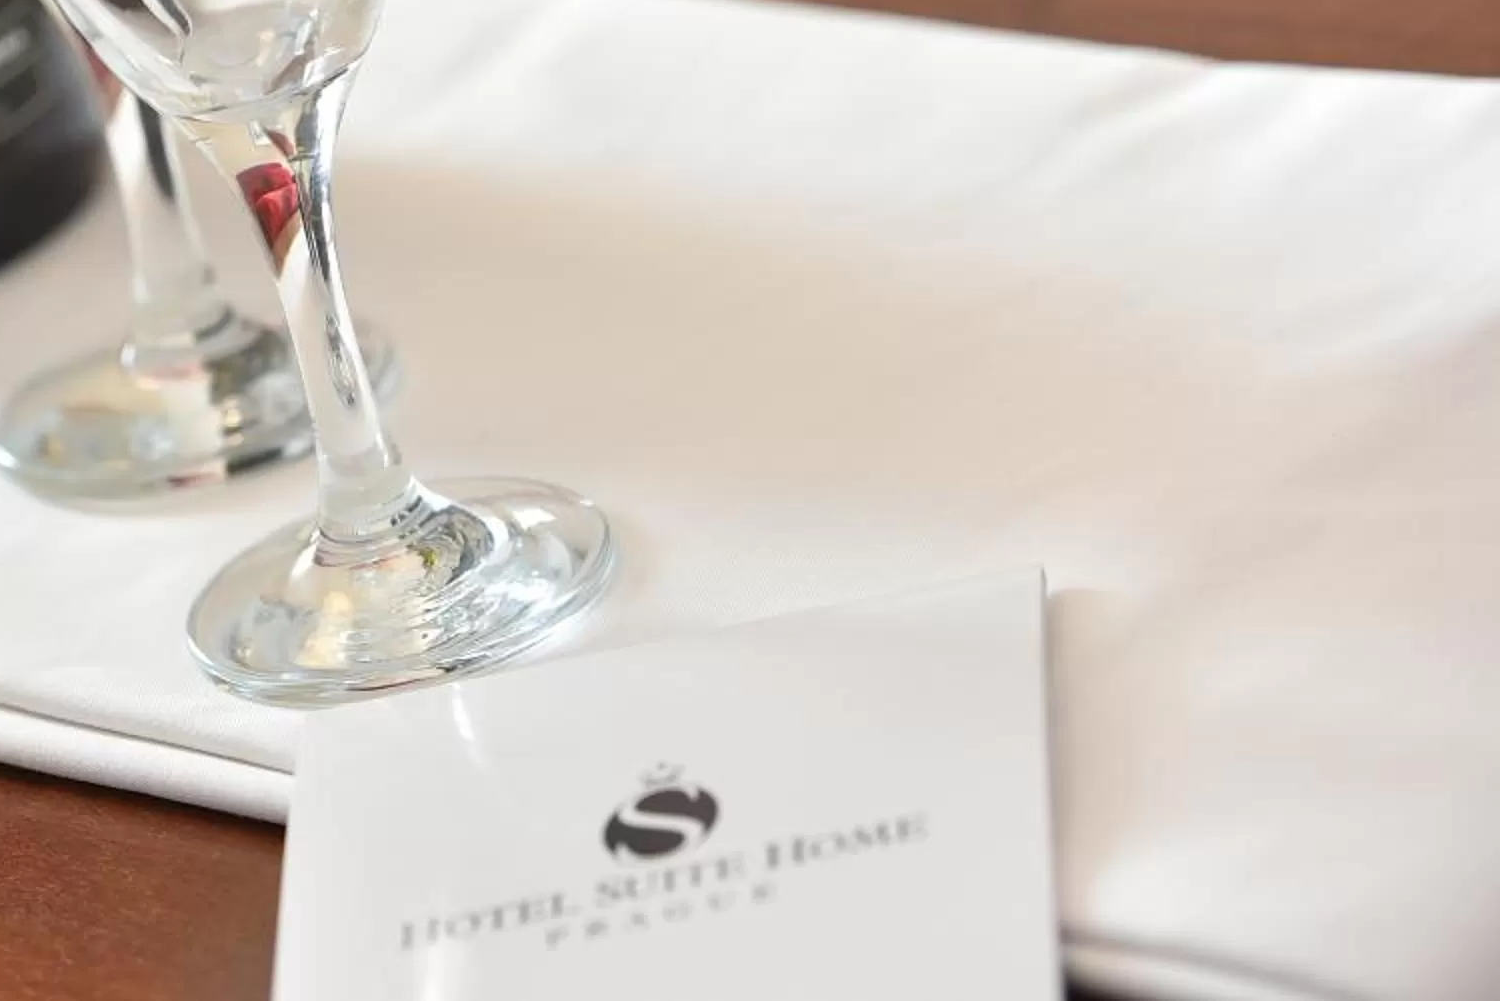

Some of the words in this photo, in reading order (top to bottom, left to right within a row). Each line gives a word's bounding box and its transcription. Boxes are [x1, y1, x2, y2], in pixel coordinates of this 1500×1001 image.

[401, 893, 579, 949] HOTEL
[595, 854, 745, 902] SUITE
[766, 814, 928, 870] HOME
